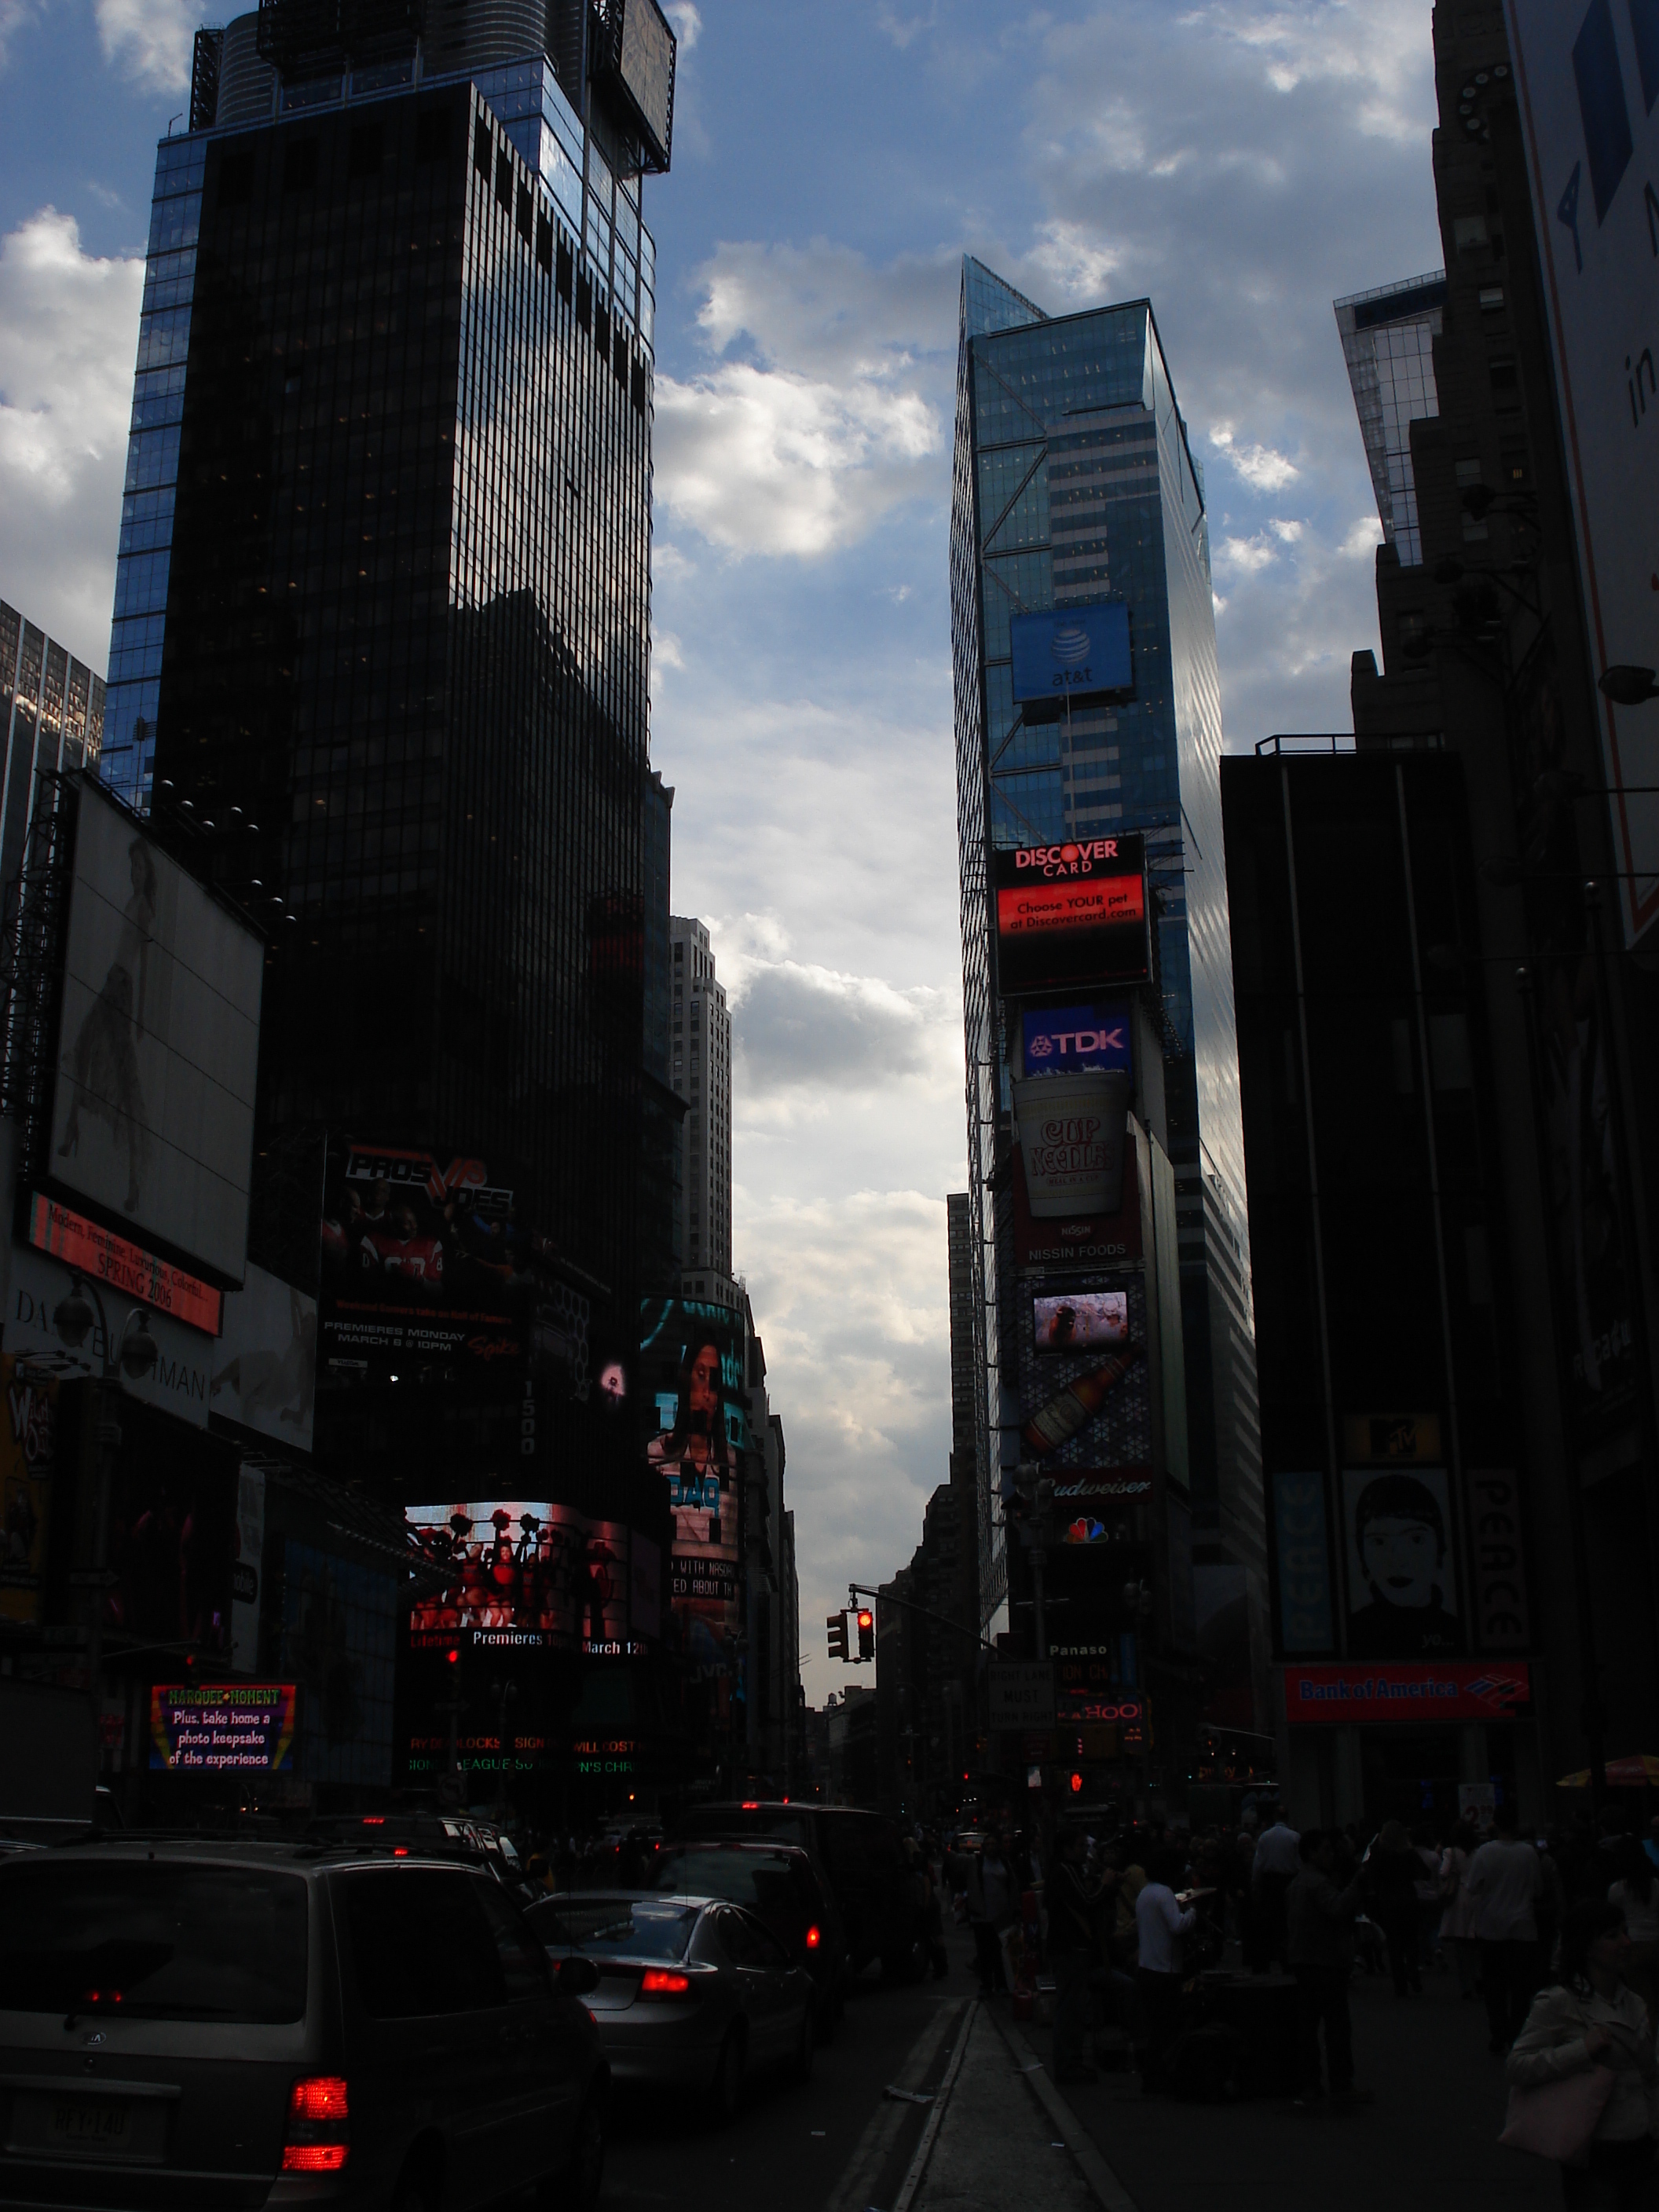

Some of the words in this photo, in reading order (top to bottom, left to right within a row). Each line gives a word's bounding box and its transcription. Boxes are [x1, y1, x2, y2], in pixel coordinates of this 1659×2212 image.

[1053, 667, 1093, 687] at&t
[1016, 840, 1119, 868] DISCOVER
[1043, 860, 1093, 877] CARD
[1017, 902, 1062, 914] Choose
[1067, 895, 1103, 908] YOUR
[1108, 894, 1128, 906] pet
[1010, 920, 1022, 929] at
[1027, 907, 1136, 928] Discovercard.com
[1051, 1027, 1124, 1055] TDK
[1041, 1116, 1101, 1147] CUP
[349, 1153, 433, 1184] PROS
[1029, 1141, 1115, 1176] NOODLES
[434, 1186, 511, 1218] JOES
[1061, 1225, 1090, 1236] NISSIN
[49, 1204, 85, 1240] Modern,
[86, 1225, 126, 1259] Feminine,
[130, 1248, 170, 1285] Luxurious,
[1029, 1247, 1074, 1261] NISSIN
[1079, 1243, 1126, 1257] FOODS
[98, 1253, 145, 1294] SPRING
[148, 1279, 171, 1308] 2006
[324, 1321, 403, 1335] PREMIERES
[408, 1328, 466, 1341] MONDAY
[338, 1334, 388, 1346] MARCH
[405, 1339, 414, 1348] @
[418, 1340, 452, 1351] 10PM
[467, 1335, 520, 1361] Spike
[93, 1326, 205, 1401] BUMAN
[521, 1380, 536, 1455] 1500
[679, 1559, 705, 1574] WITH
[1280, 1481, 1326, 1639] PEACE
[1474, 1479, 1522, 1635] PEACE
[672, 1578, 687, 1594] ED
[692, 1579, 720, 1595] ABOUT
[410, 1633, 460, 1649] Lifetime
[473, 1632, 542, 1646] Premieres
[582, 1640, 621, 1654] March
[991, 1670, 1020, 1682] RIGHT
[1025, 1671, 1052, 1682] LANE
[168, 1689, 224, 1705] MARQUEE
[229, 1689, 280, 1705] MOMENT
[1004, 1690, 1038, 1703] MUST
[1299, 1679, 1352, 1700] Bank
[1353, 1678, 1373, 1699] of
[1375, 1677, 1458, 1699] America
[203, 1711, 228, 1725] take
[230, 1712, 260, 1724] home
[263, 1714, 270, 1724] a
[991, 1712, 1018, 1723] TURN
[1023, 1711, 1053, 1722] RIGHT
[178, 1730, 210, 1749] photo
[212, 1730, 266, 1749] keepsake
[515, 1737, 544, 1749] SIGN
[169, 1749, 181, 1765] of
[184, 1750, 203, 1764] the
[206, 1752, 269, 1769] experience
[460, 1758, 511, 1771] EAGUE
